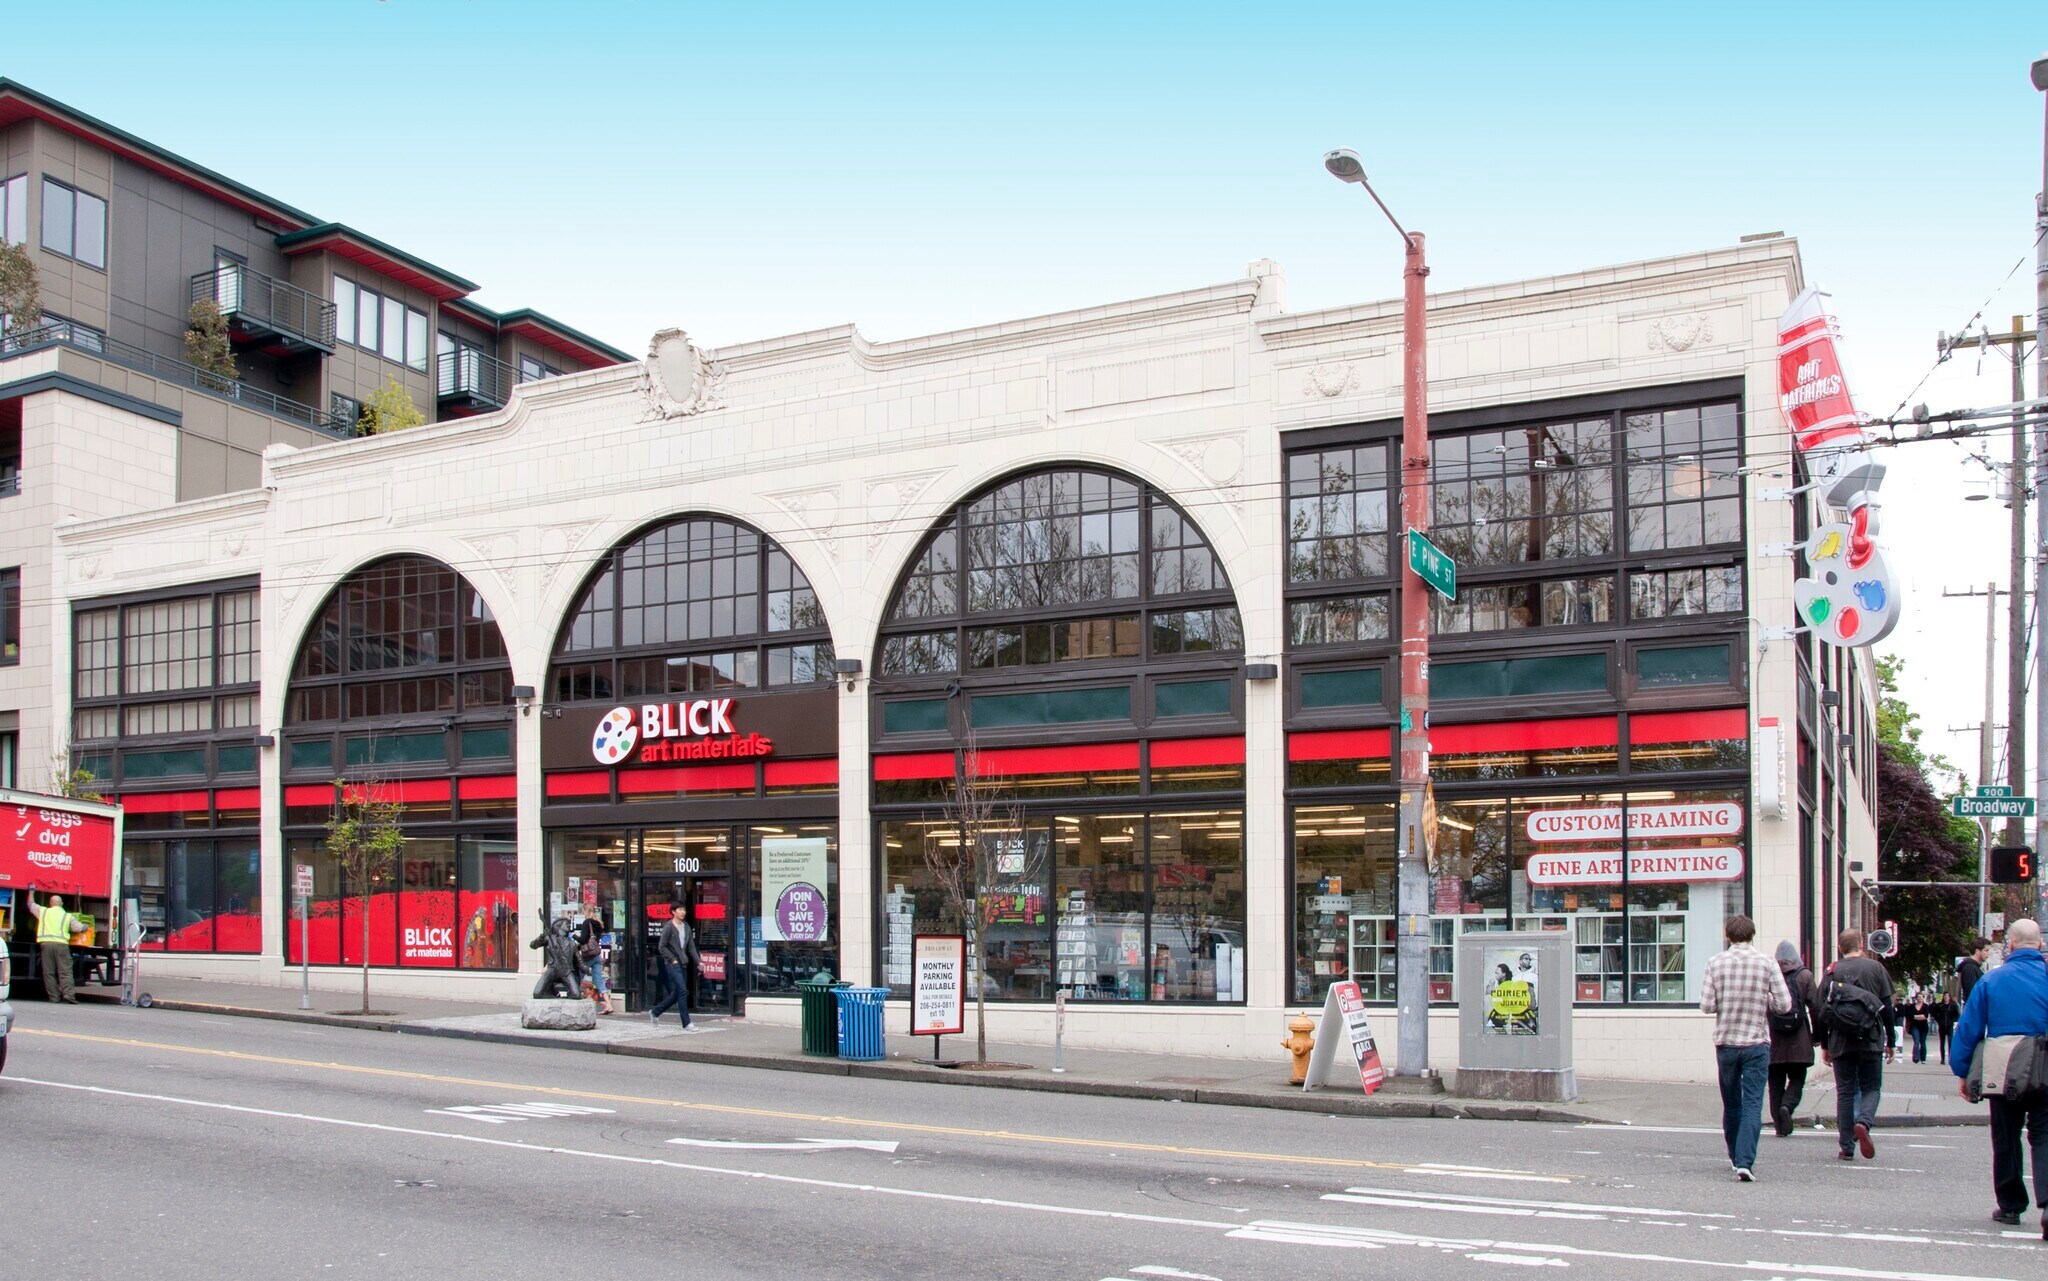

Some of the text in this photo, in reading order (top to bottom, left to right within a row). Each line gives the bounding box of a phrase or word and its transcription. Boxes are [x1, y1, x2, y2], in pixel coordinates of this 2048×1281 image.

[1797, 358, 1822, 385] ART
[1782, 374, 1841, 411] MATERIALS
[1412, 540, 1452, 585] E PINE ST
[642, 698, 734, 739] BLICK
[640, 732, 772, 762] art materials
[1983, 788, 2004, 797] 900
[1961, 798, 2026, 816] Broadway
[39, 809, 83, 828] eggs
[1535, 809, 1730, 832] CUSTOM FRAMING
[39, 829, 70, 847] dvd
[27, 850, 73, 864] amazon
[673, 857, 699, 873] 1600
[1538, 855, 1729, 876] FINE ART PRINTING
[2019, 854, 2029, 877] 5
[789, 891, 812, 904] JOIN
[794, 901, 808, 912] TO
[788, 911, 814, 922] SAVE
[404, 926, 452, 946] BLICK
[789, 922, 815, 933] 10%
[405, 947, 453, 957] art materials
[922, 962, 954, 970] MONTHLY
[923, 972, 953, 980] PARKING
[920, 982, 956, 991] AVAILABLE
